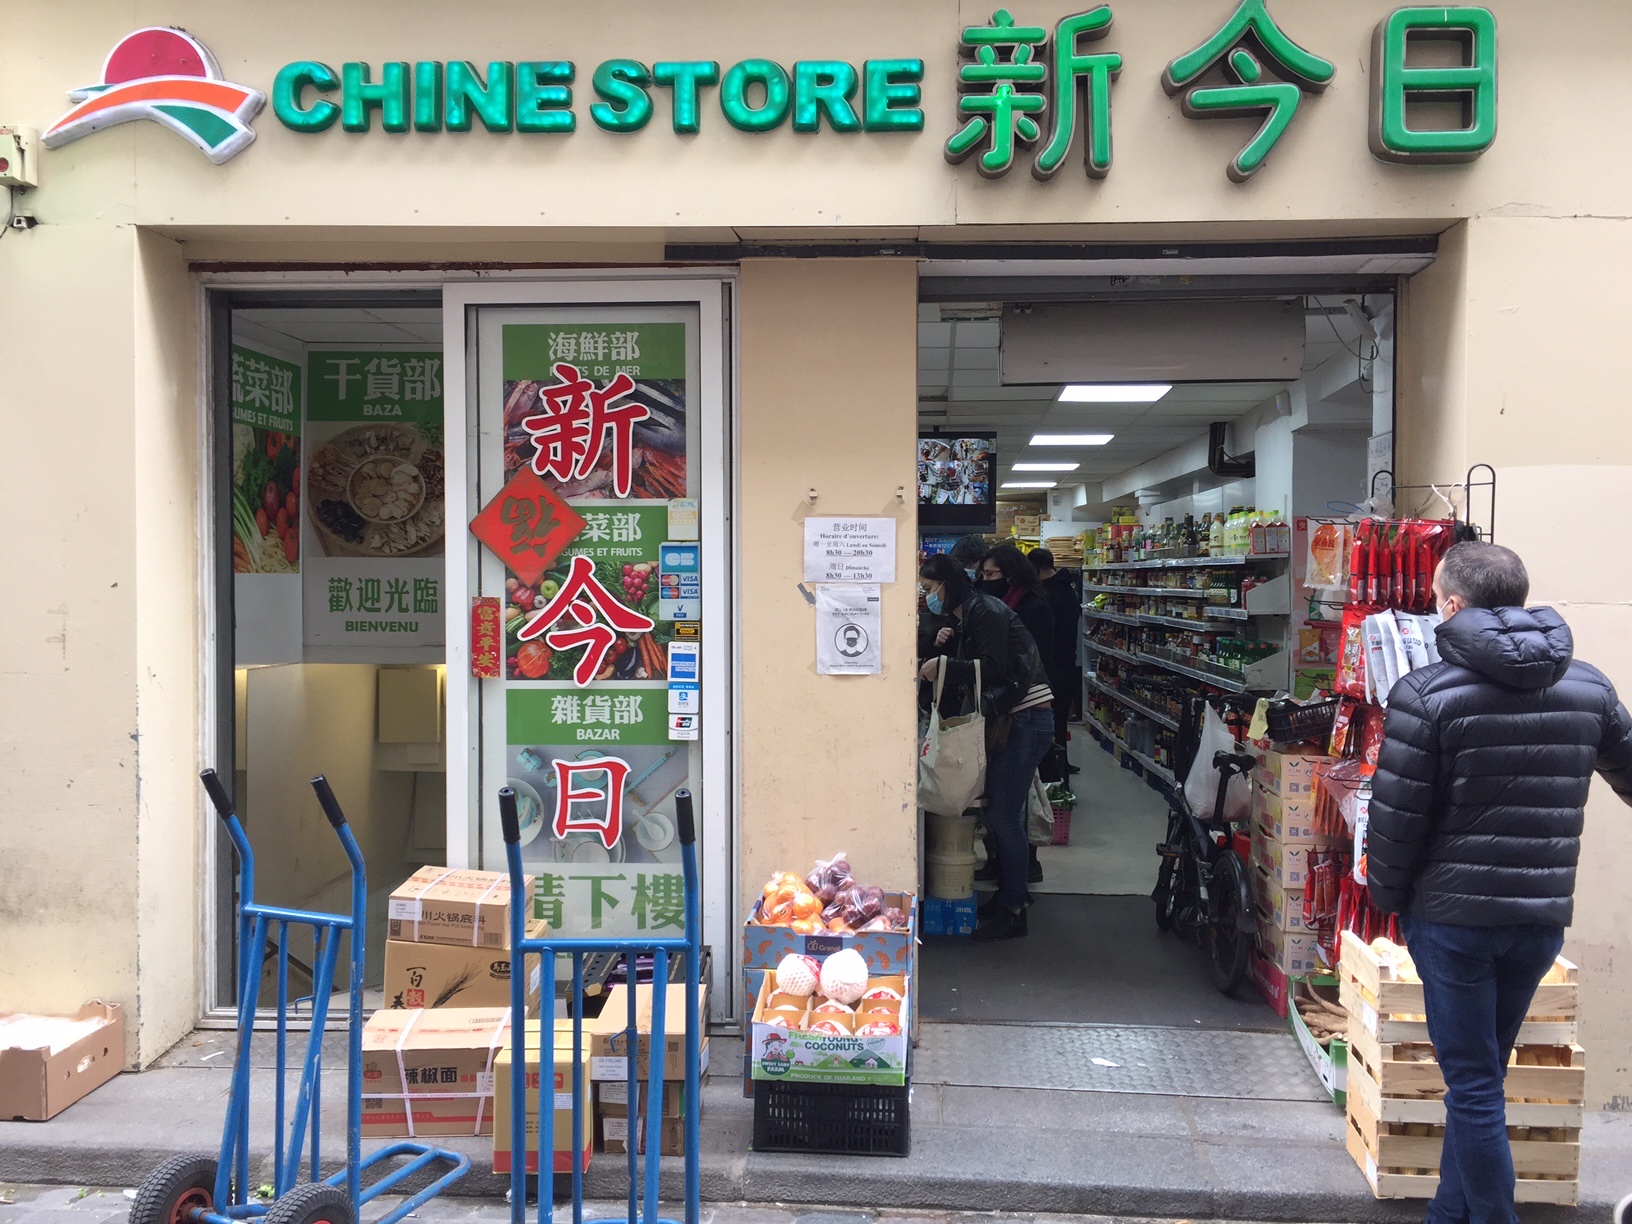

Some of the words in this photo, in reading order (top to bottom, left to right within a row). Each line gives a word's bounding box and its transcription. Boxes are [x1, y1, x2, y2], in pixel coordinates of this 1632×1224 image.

[272, 60, 575, 134] CHINE
[589, 58, 925, 135] STORE
[944, 0, 1498, 184] 新今日
[548, 331, 641, 361] 海鮮部
[323, 357, 441, 400] 干貨部
[594, 366, 610, 376] DE
[616, 365, 641, 376] MER
[232, 406, 256, 423] UMES
[257, 412, 268, 426] ET
[269, 414, 293, 431] FRUITS
[362, 404, 402, 416] BAZA
[573, 512, 642, 542] 菜部
[833, 523, 867, 531] 营业时间
[560, 548, 594, 556] GUMES
[597, 548, 608, 556] ET
[610, 548, 643, 556] FRUITS
[665, 553, 695, 566] CB
[328, 577, 438, 615] 歡迎光臨
[517, 362, 656, 850] 新今日
[345, 621, 419, 633] BIENVENU
[551, 695, 644, 725] 雜貨部
[576, 729, 620, 740] BAZAR
[804, 1041, 864, 1051] COCONUTS
[403, 1066, 458, 1085] 辣椒面
[833, 1074, 866, 1082] THAILAND
